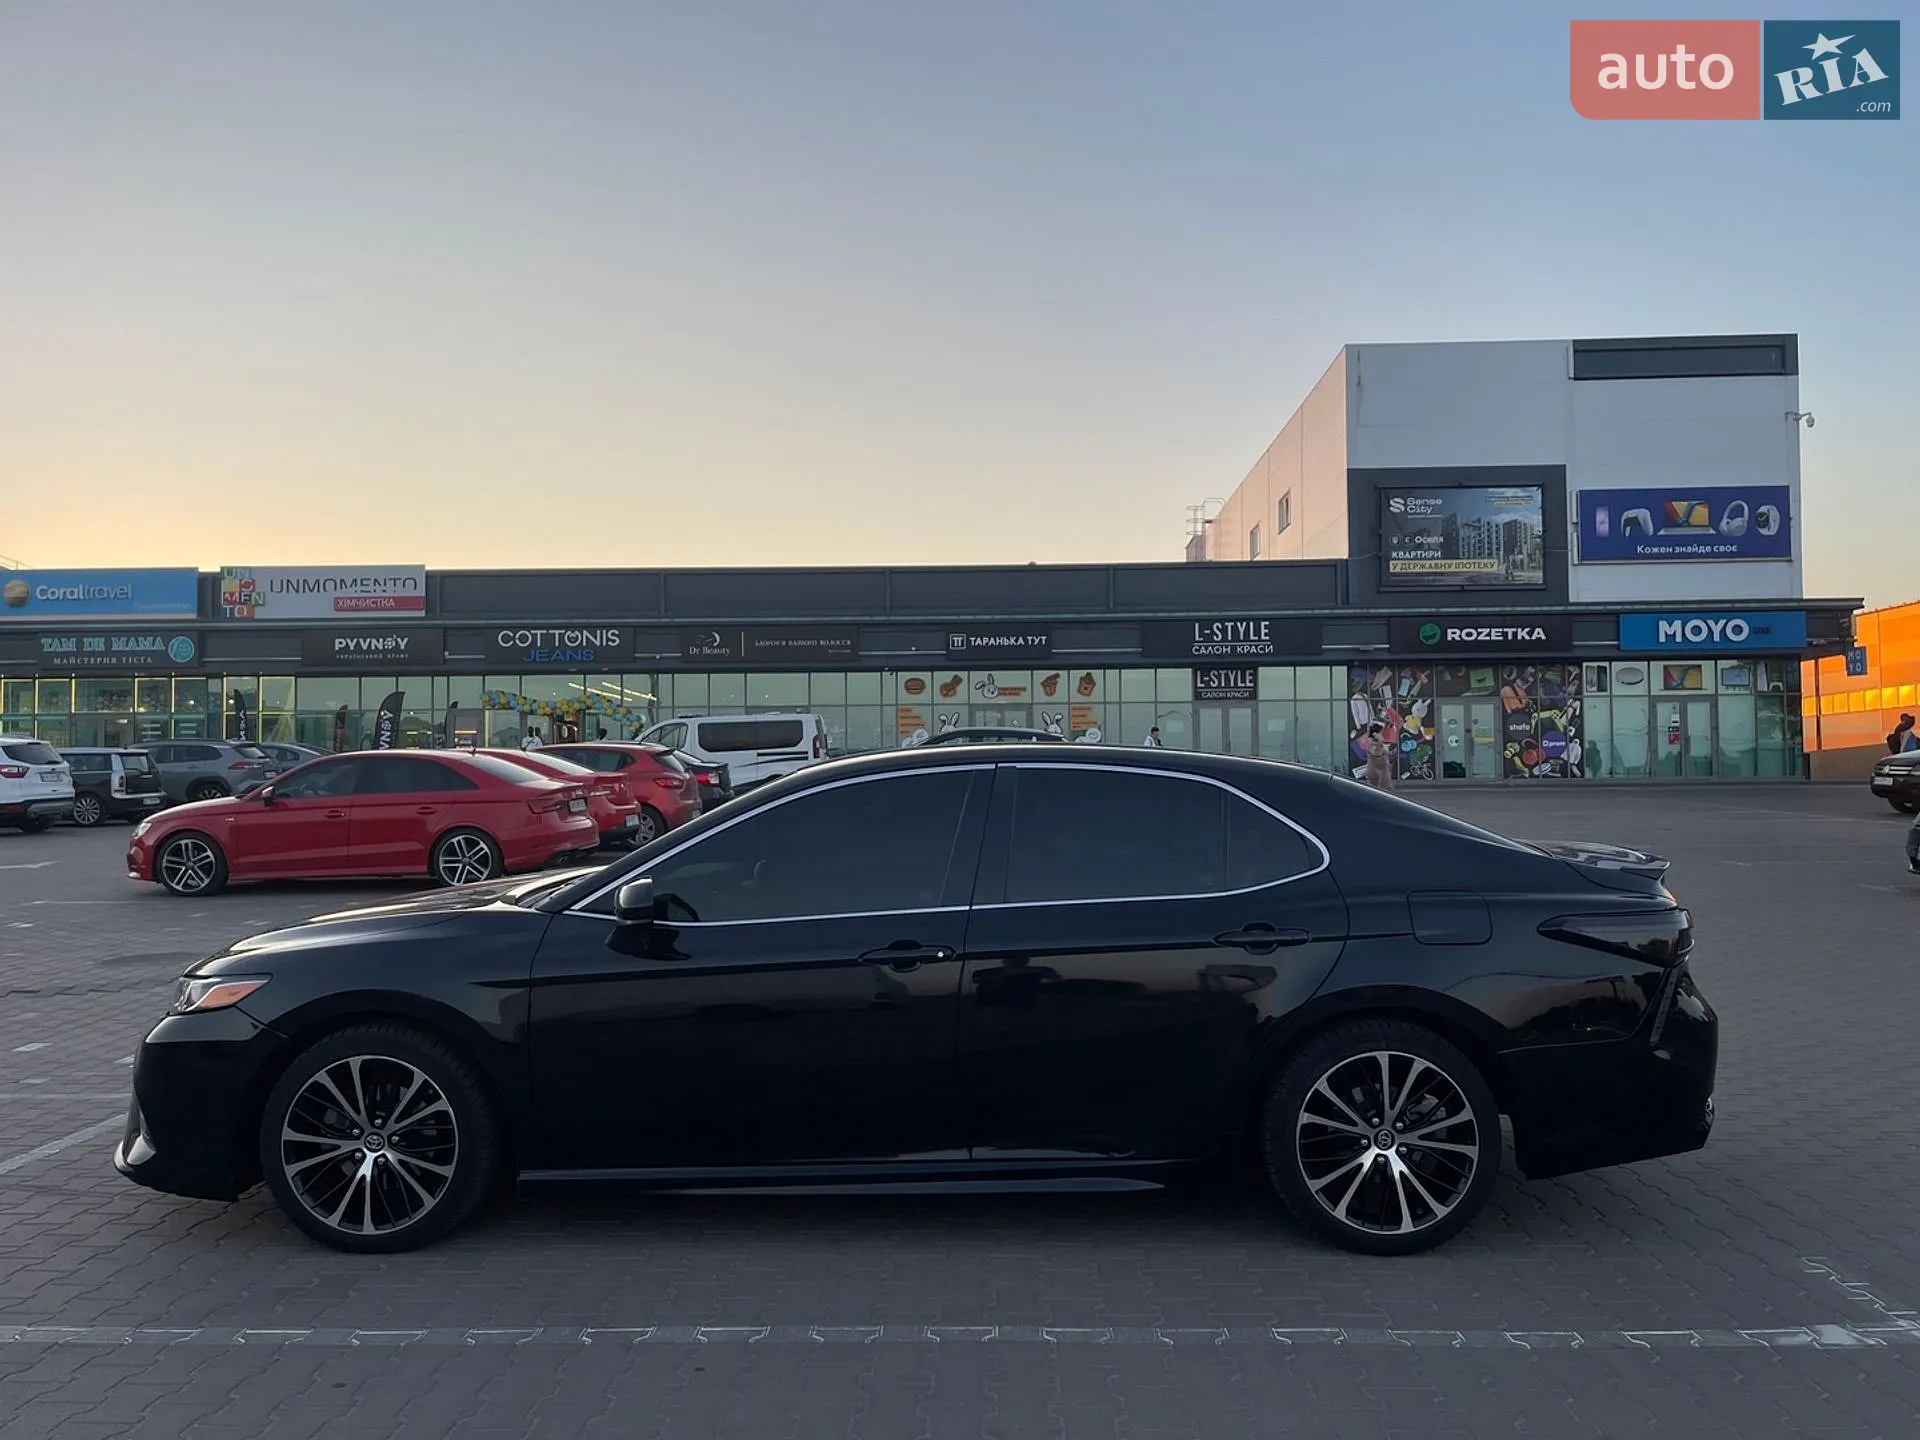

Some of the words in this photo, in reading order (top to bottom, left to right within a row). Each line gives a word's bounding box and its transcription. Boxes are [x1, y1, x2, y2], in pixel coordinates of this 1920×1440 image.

[1407, 497, 1442, 505] Sense
[1407, 505, 1432, 514] City
[1637, 545, 1673, 554] Кожен
[1674, 544, 1712, 553] знайде
[1392, 551, 1441, 559] КВАРТИРИ
[1401, 562, 1453, 570] ДЕРЖАВНУ
[1455, 561, 1495, 569] ІПОТЕКУ
[337, 599, 395, 608] ХІМЧИСТКА
[1194, 621, 1270, 641] L-STYLE
[1446, 627, 1547, 641] ROZETKA
[1658, 618, 1750, 643] MOYO
[498, 629, 620, 647] COTTONIS
[969, 637, 1025, 646] ТАРАНЬКА
[1027, 636, 1048, 645] ТУТ
[702, 646, 730, 656] Beauty
[1192, 646, 1231, 655] САЛОН
[1237, 645, 1274, 653] КРАСИ
[523, 650, 594, 662] JEANS
[1197, 670, 1254, 687] L-STYLE
